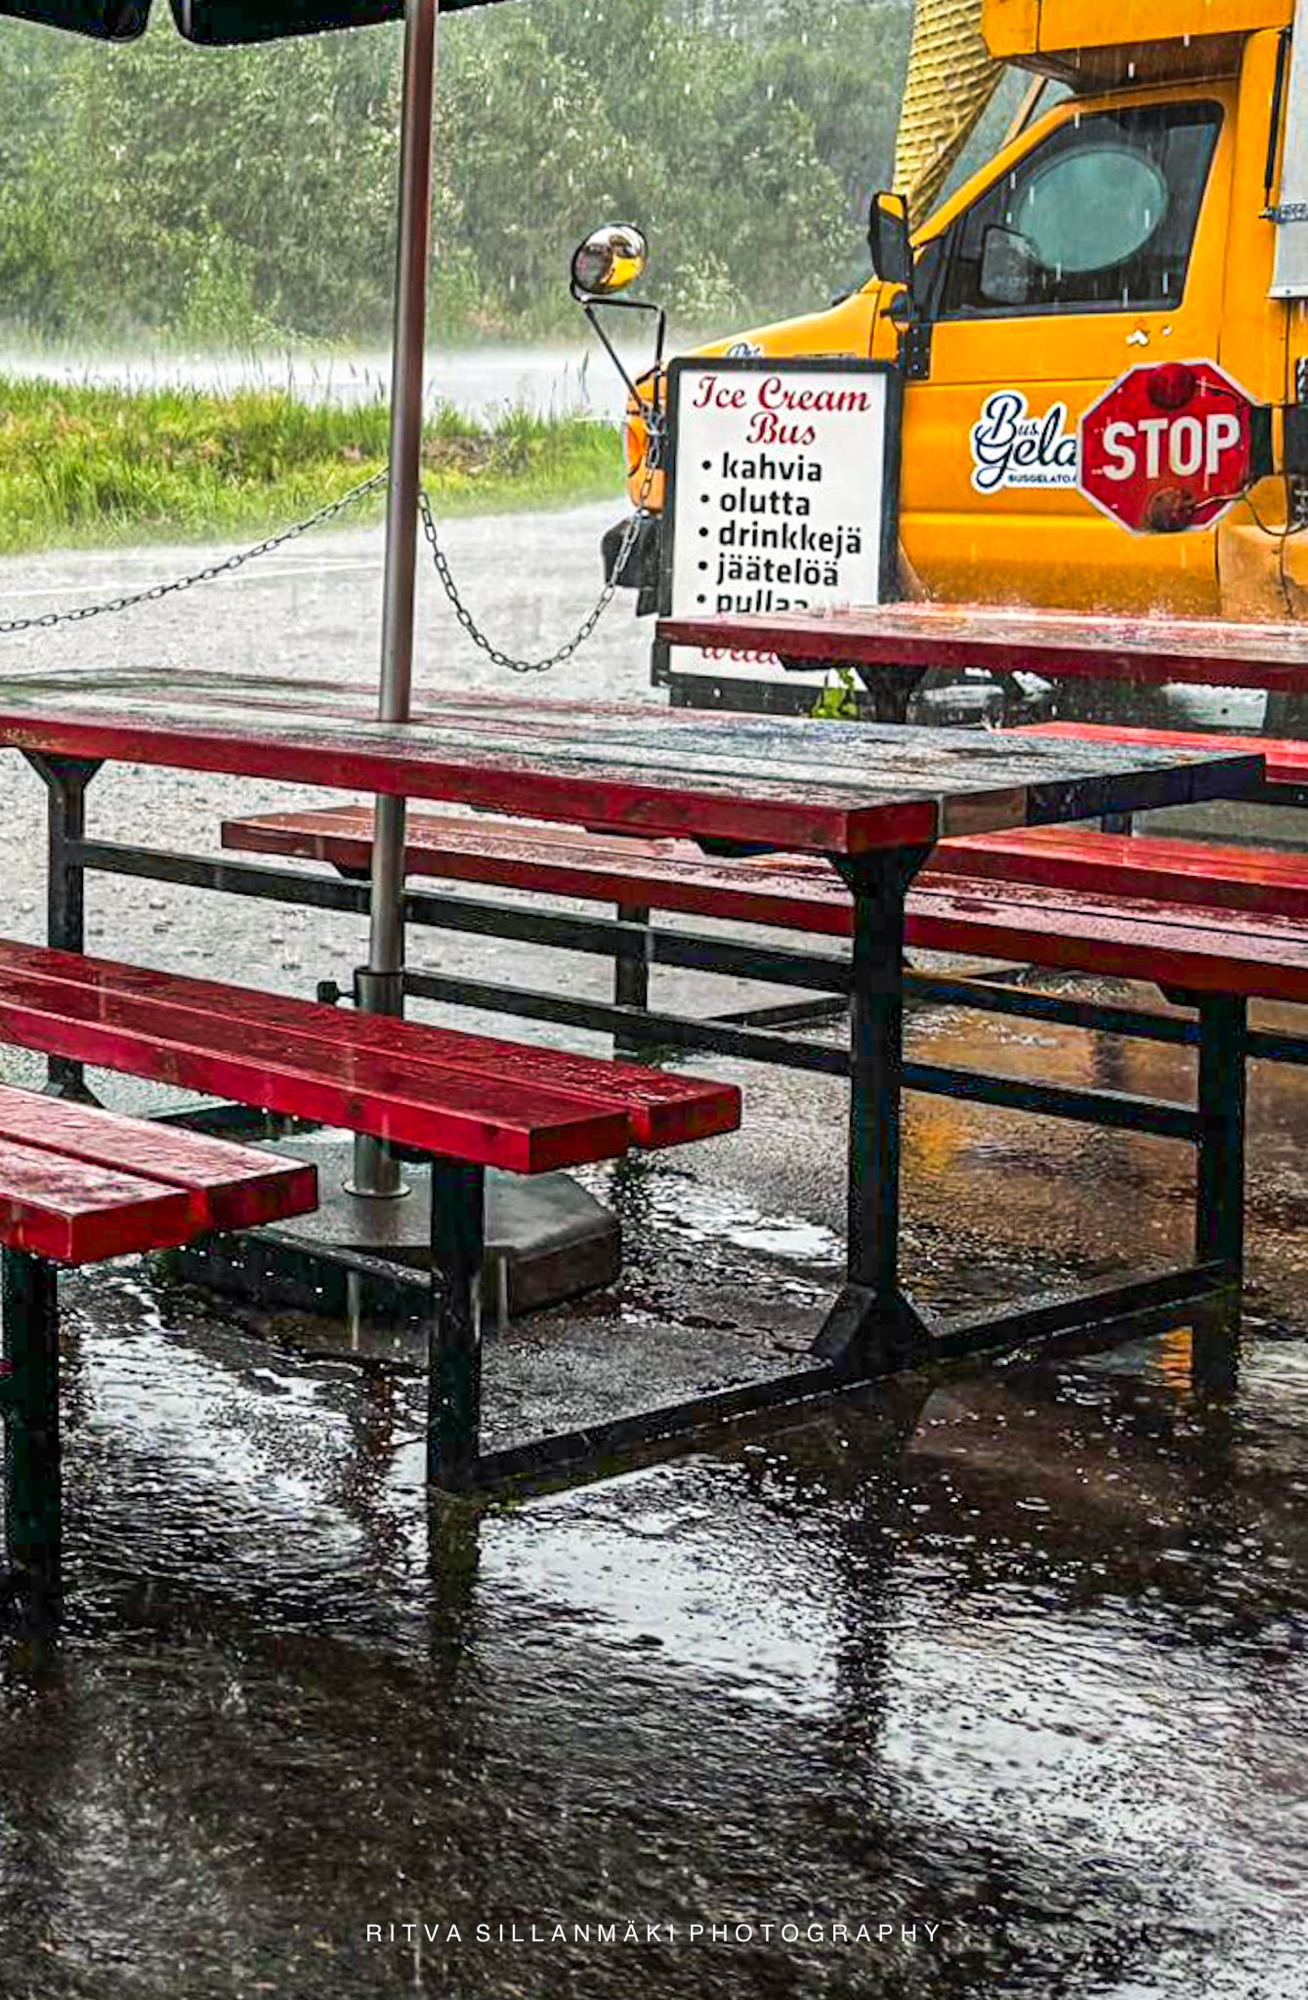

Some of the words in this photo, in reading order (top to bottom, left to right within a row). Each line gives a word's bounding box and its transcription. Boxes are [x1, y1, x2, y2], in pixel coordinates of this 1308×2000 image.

[692, 375, 747, 410] Ice
[757, 377, 871, 412] Cream
[746, 411, 816, 446] Bus
[1102, 413, 1241, 481] STOP
[722, 452, 823, 482] kahvia
[1008, 474, 1076, 483] BUSGELATO.
[719, 487, 811, 516] olutta
[718, 520, 862, 559] drinkkejä
[715, 553, 839, 587] jäätelöä
